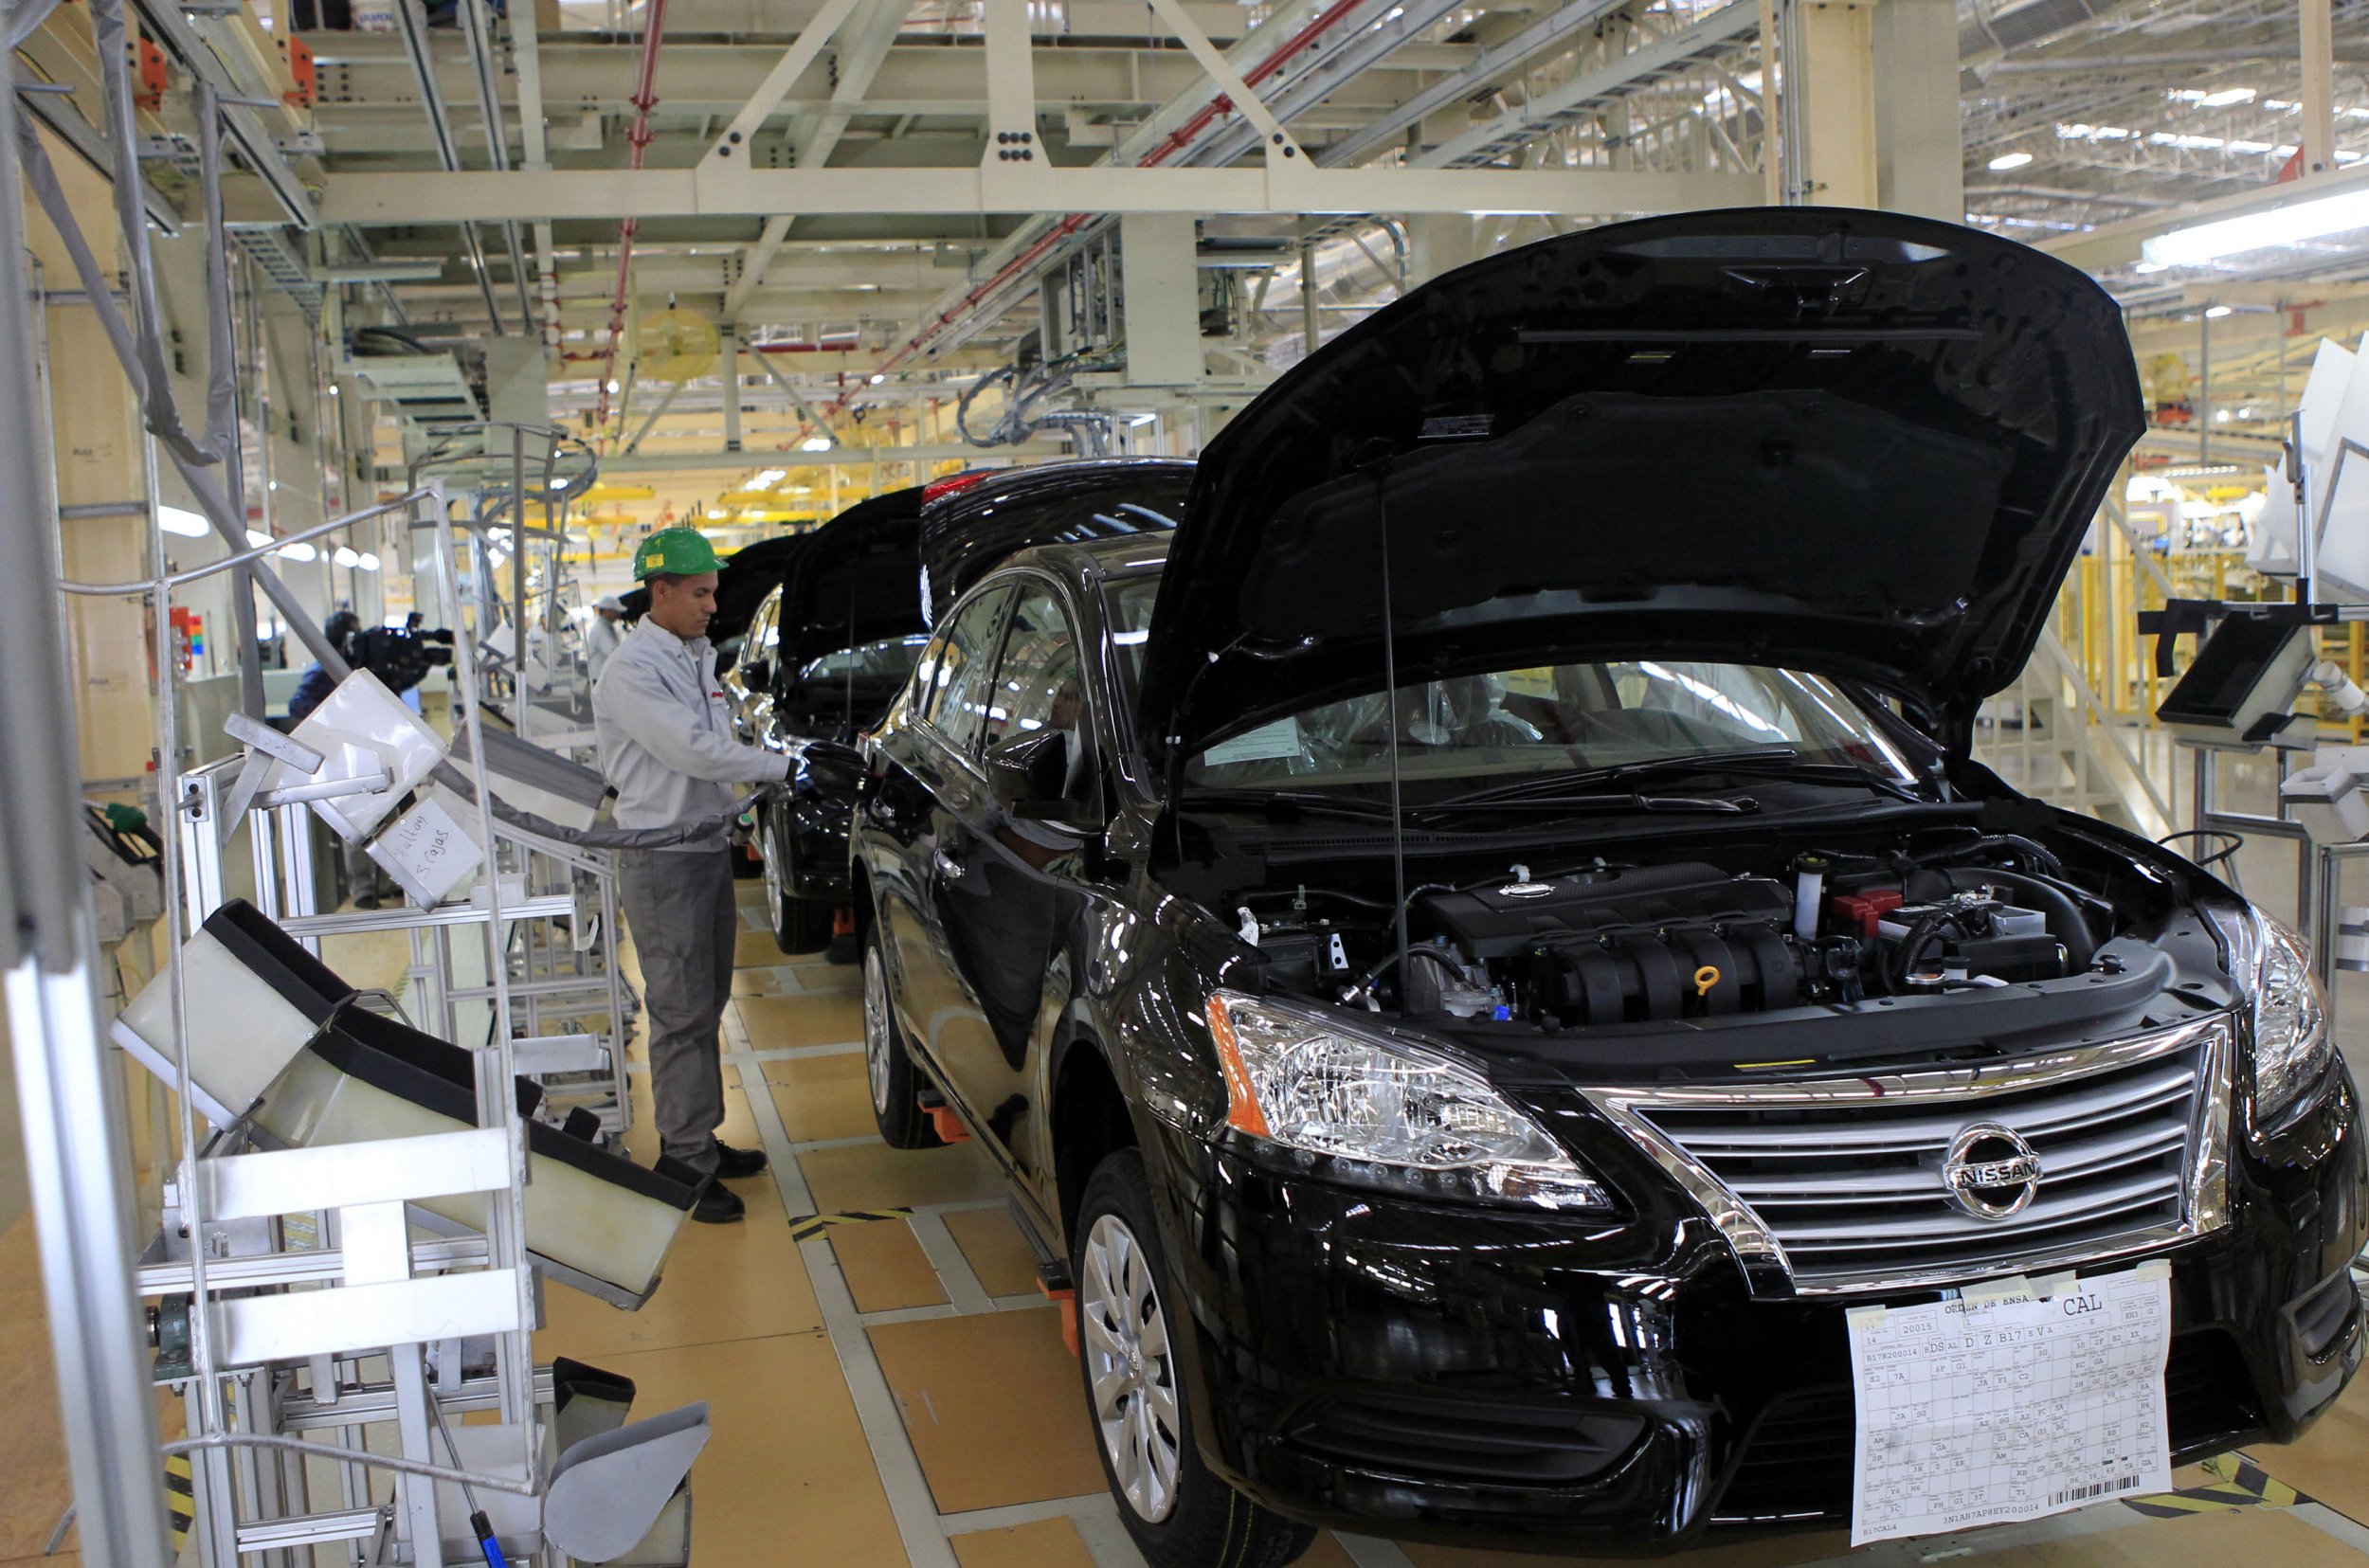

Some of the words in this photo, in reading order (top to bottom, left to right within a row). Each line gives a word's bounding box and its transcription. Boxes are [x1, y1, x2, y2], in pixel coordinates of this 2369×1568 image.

[1961, 1162, 2036, 1183] NISSAN
[1983, 1300, 1997, 1308] DE
[2003, 1295, 2029, 1306] ENSA
[2063, 1294, 2103, 1316] CAL
[1903, 1322, 1933, 1334] 20015
[1965, 1338, 1974, 1348] D
[1984, 1335, 1992, 1345] Z
[1998, 1331, 2022, 1343] B17
